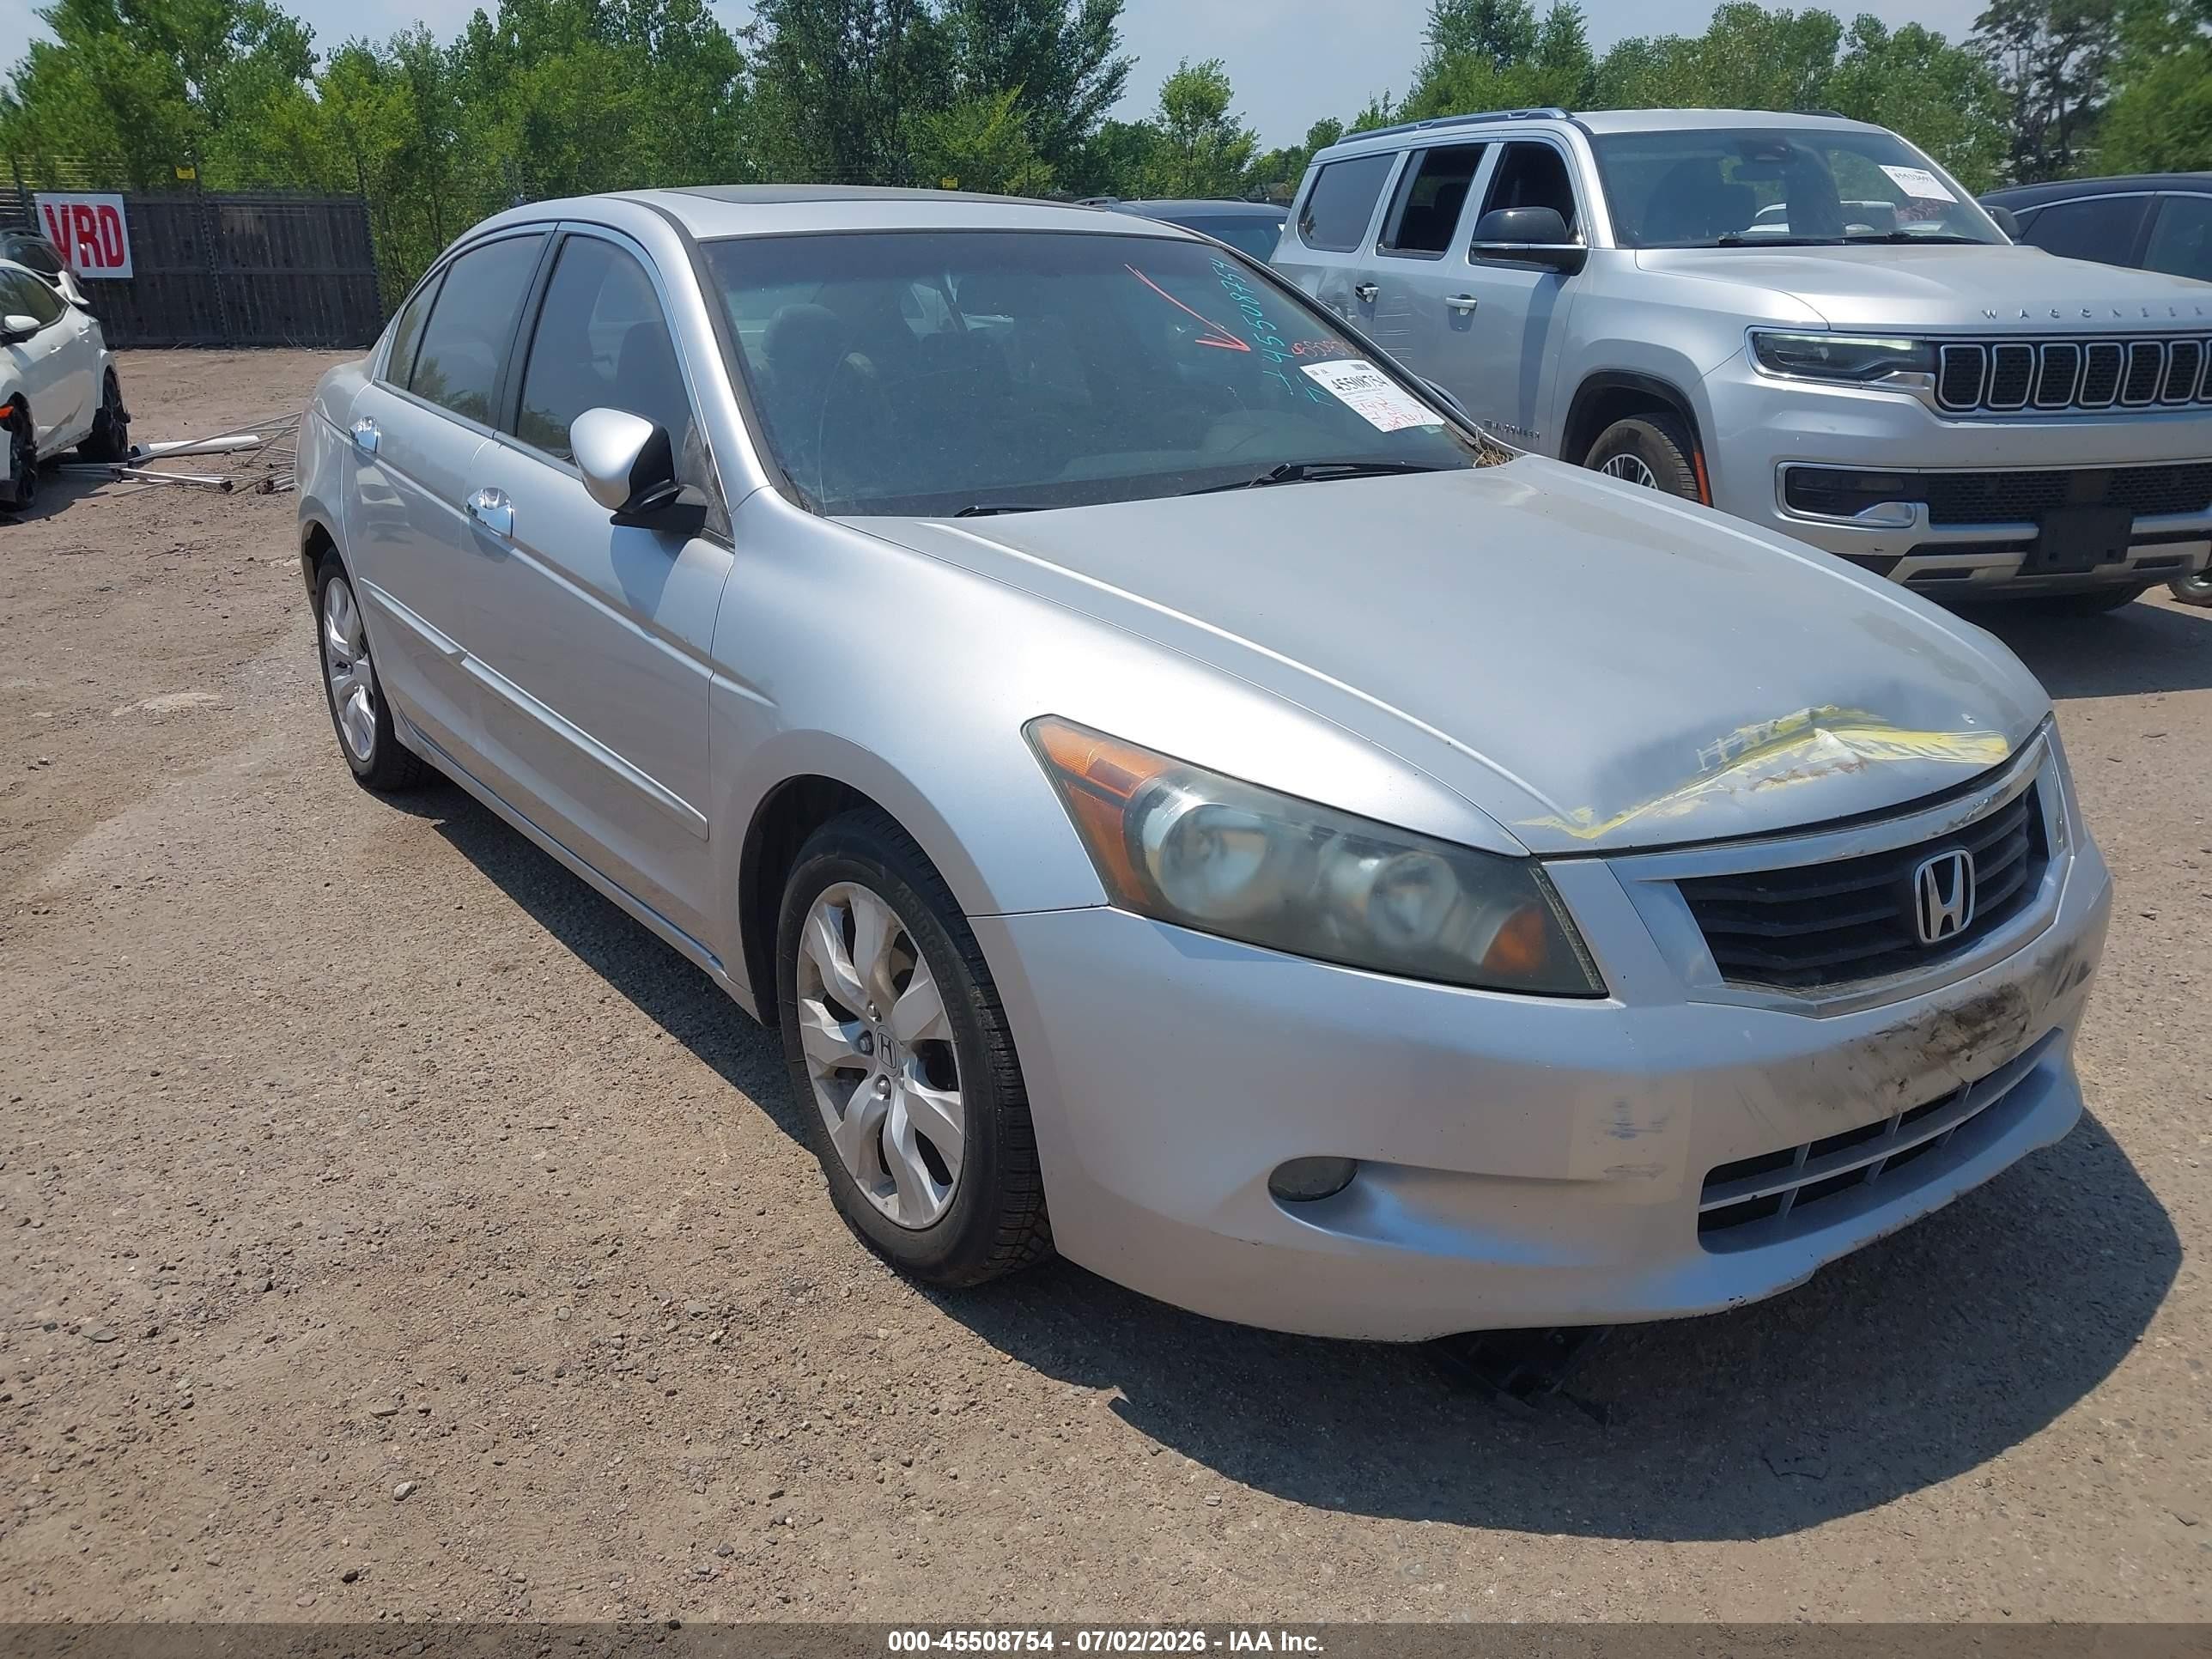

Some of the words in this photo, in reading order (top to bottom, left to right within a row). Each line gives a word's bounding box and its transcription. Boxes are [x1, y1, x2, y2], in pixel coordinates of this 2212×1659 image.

[43, 204, 125, 268] VRD
[1210, 258, 1294, 363] 45508754
[1330, 374, 1390, 392] 45508754
